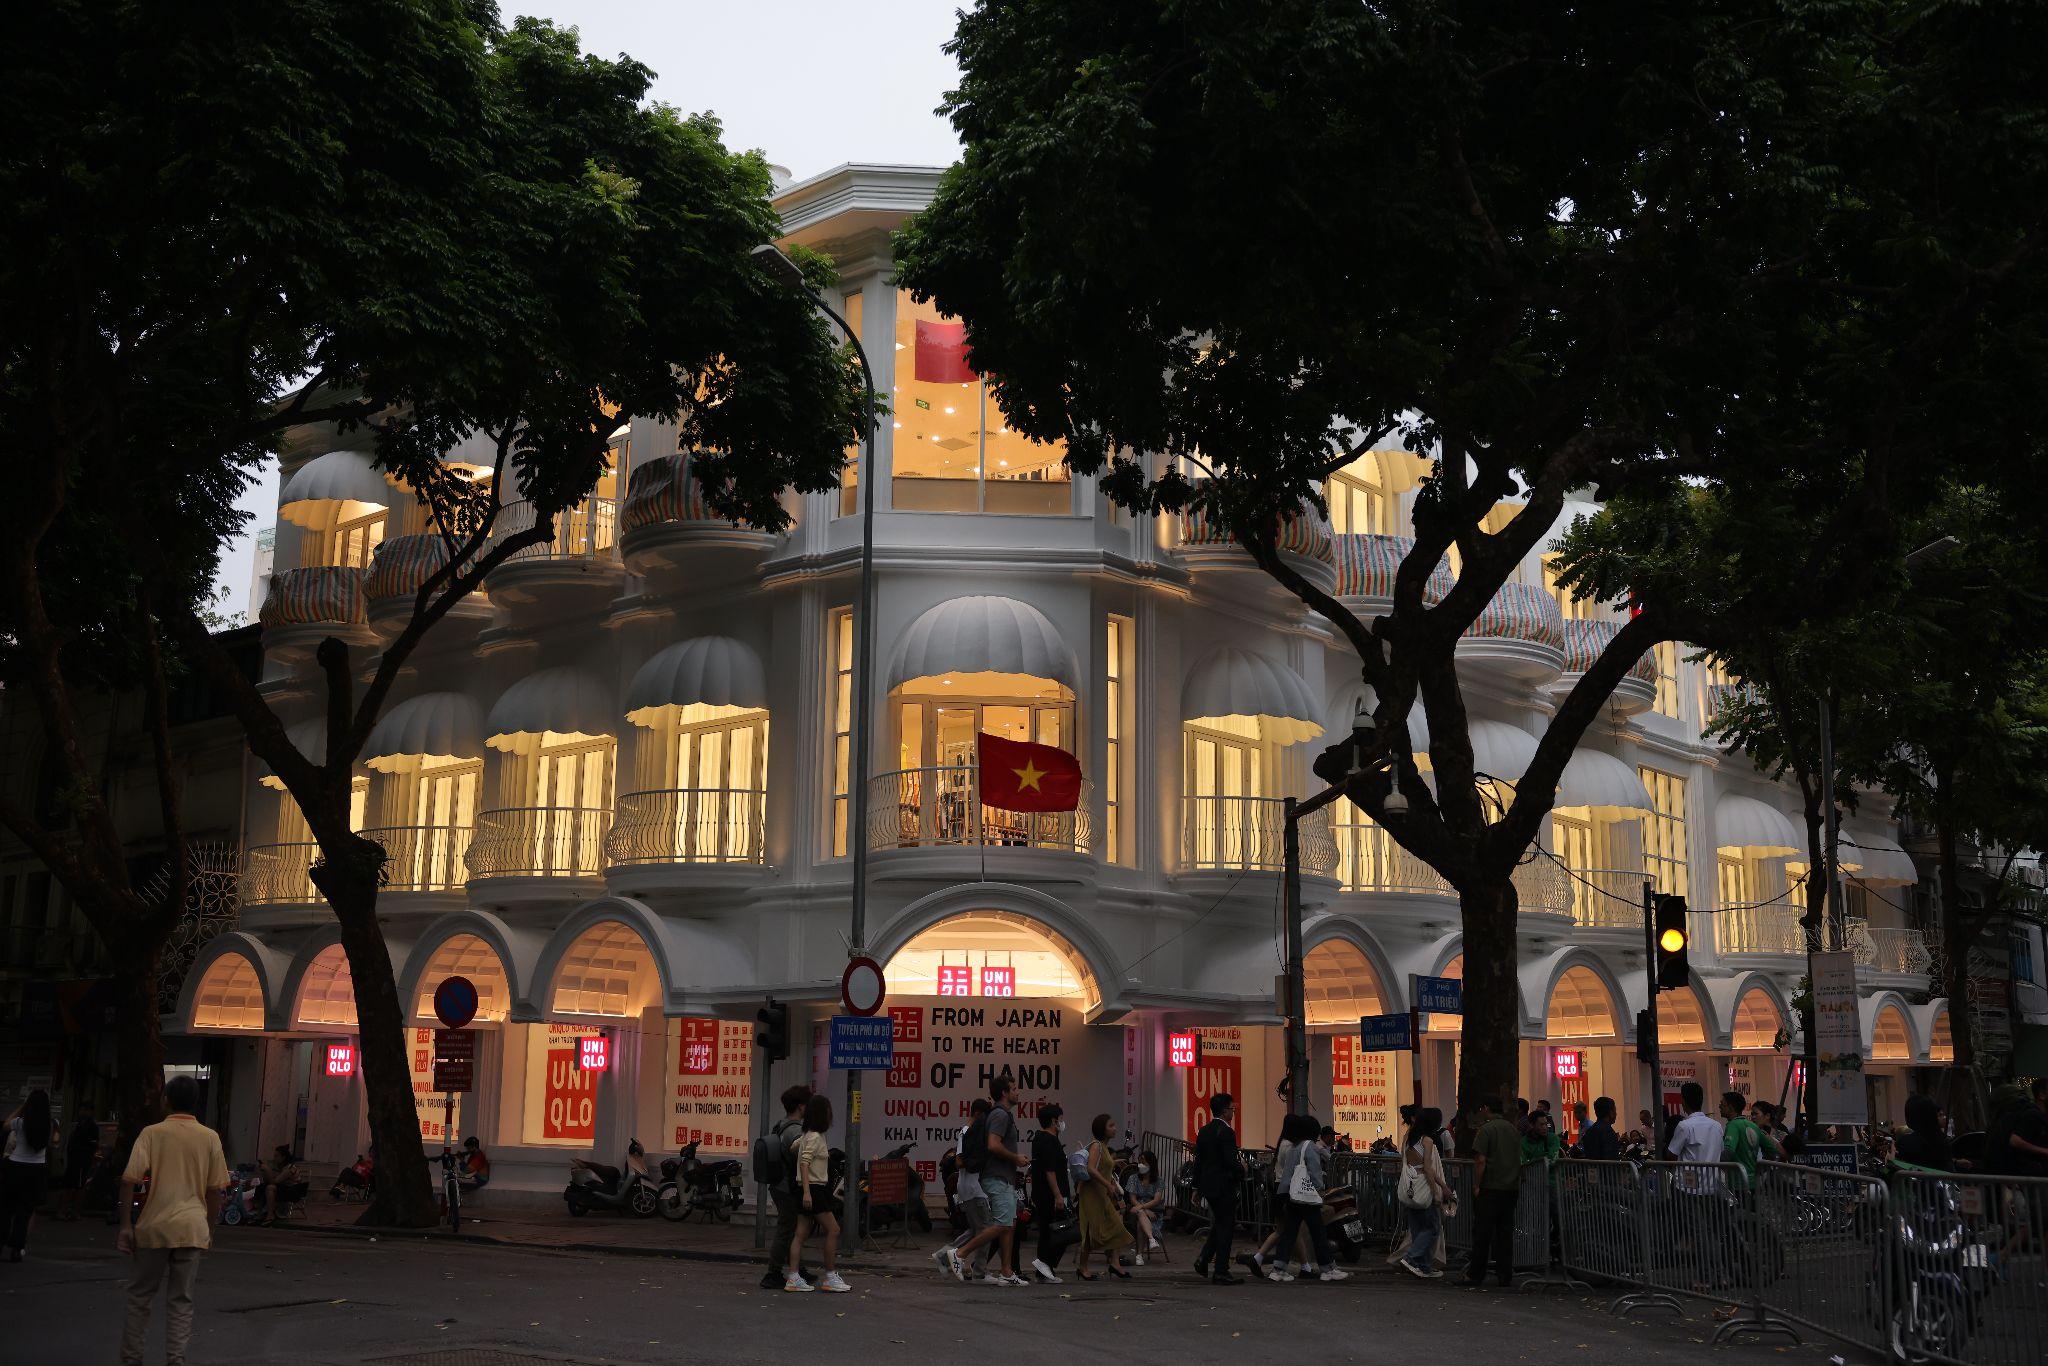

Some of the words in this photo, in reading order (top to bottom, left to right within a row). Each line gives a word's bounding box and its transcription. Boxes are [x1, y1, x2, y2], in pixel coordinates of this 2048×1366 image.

[984, 971, 1010, 984] UNI
[932, 1008, 984, 1027] FROM
[996, 1009, 1061, 1028] JAPAN
[583, 1041, 604, 1053] UNI
[932, 1037, 953, 1053] TO
[962, 1037, 994, 1054] THE
[1003, 1038, 1061, 1055] HEART
[1172, 1038, 1192, 1050] UNI
[330, 1049, 350, 1060] UNI
[1172, 1051, 1193, 1065] QLO
[1557, 1055, 1575, 1065] UNI
[329, 1061, 351, 1074] QLO
[582, 1055, 605, 1069] QLO
[892, 1056, 916, 1069] UNI
[553, 1060, 591, 1090] UNI
[890, 1071, 917, 1085] QLO
[931, 1063, 965, 1089] OF
[1557, 1066, 1577, 1076] QLO
[677, 1084, 709, 1099] UNIQLO
[713, 1081, 738, 1098] HOÀN
[1194, 1068, 1231, 1099] UNI
[551, 1098, 593, 1132] QLO
[675, 1102, 691, 1114] KHAI
[885, 1099, 950, 1120] UNIQLO
[885, 1127, 918, 1141] KHAI
[1841, 1153, 1853, 1164] XE
